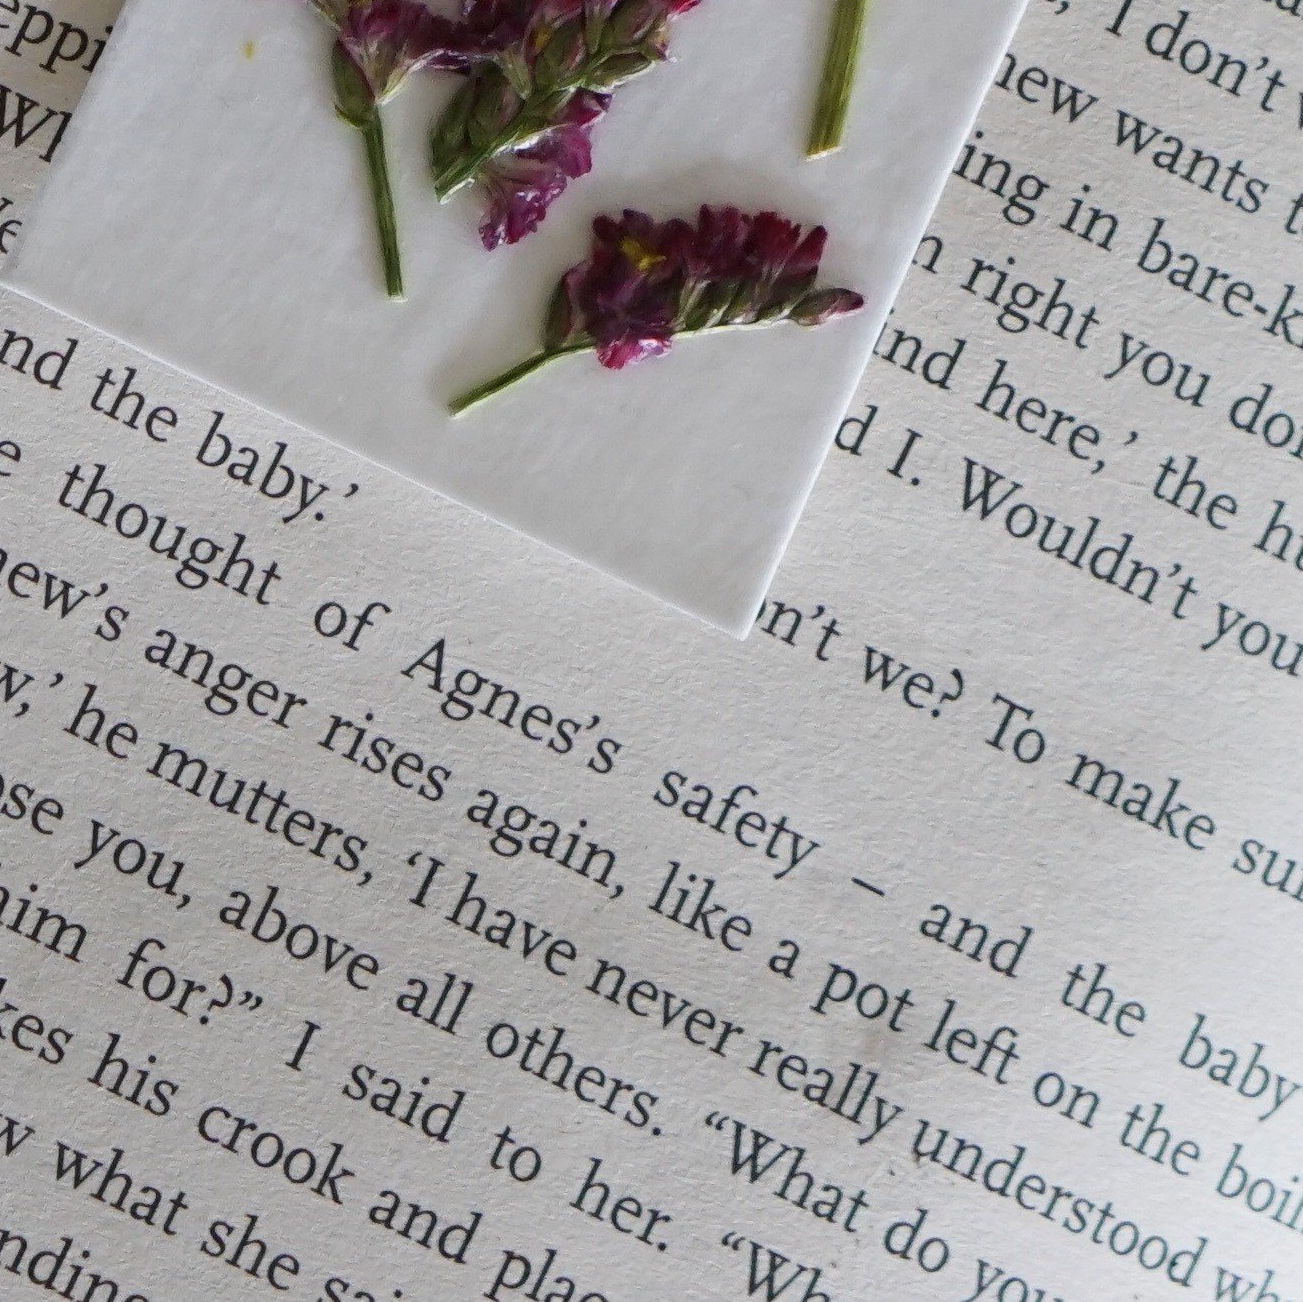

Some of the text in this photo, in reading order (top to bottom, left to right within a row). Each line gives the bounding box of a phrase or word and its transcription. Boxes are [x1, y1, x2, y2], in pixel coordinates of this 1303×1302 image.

[1116, 110, 1269, 214] wants
[90, 367, 178, 443] the
[960, 258, 1099, 350] right
[1103, 332, 1211, 407] you
[887, 428, 923, 487] I.
[962, 457, 1197, 620] Wouldn’t
[58, 463, 281, 606] thought
[313, 601, 392, 651] of
[400, 638, 622, 774] Agnes’s
[653, 771, 820, 880] safety
[919, 904, 1034, 979] and
[1061, 963, 1146, 1038] the
[864, 646, 965, 719] we?
[985, 693, 1046, 764] To
[1065, 753, 1216, 851] make
[73, 819, 191, 910] you,
[218, 885, 380, 991] above
[396, 972, 475, 1035] all
[485, 1021, 662, 1137] others.
[883, 1207, 950, 1273] do
[87, 1032, 179, 1117] his
[197, 1106, 355, 1205] crook
[368, 1190, 483, 1265] and
